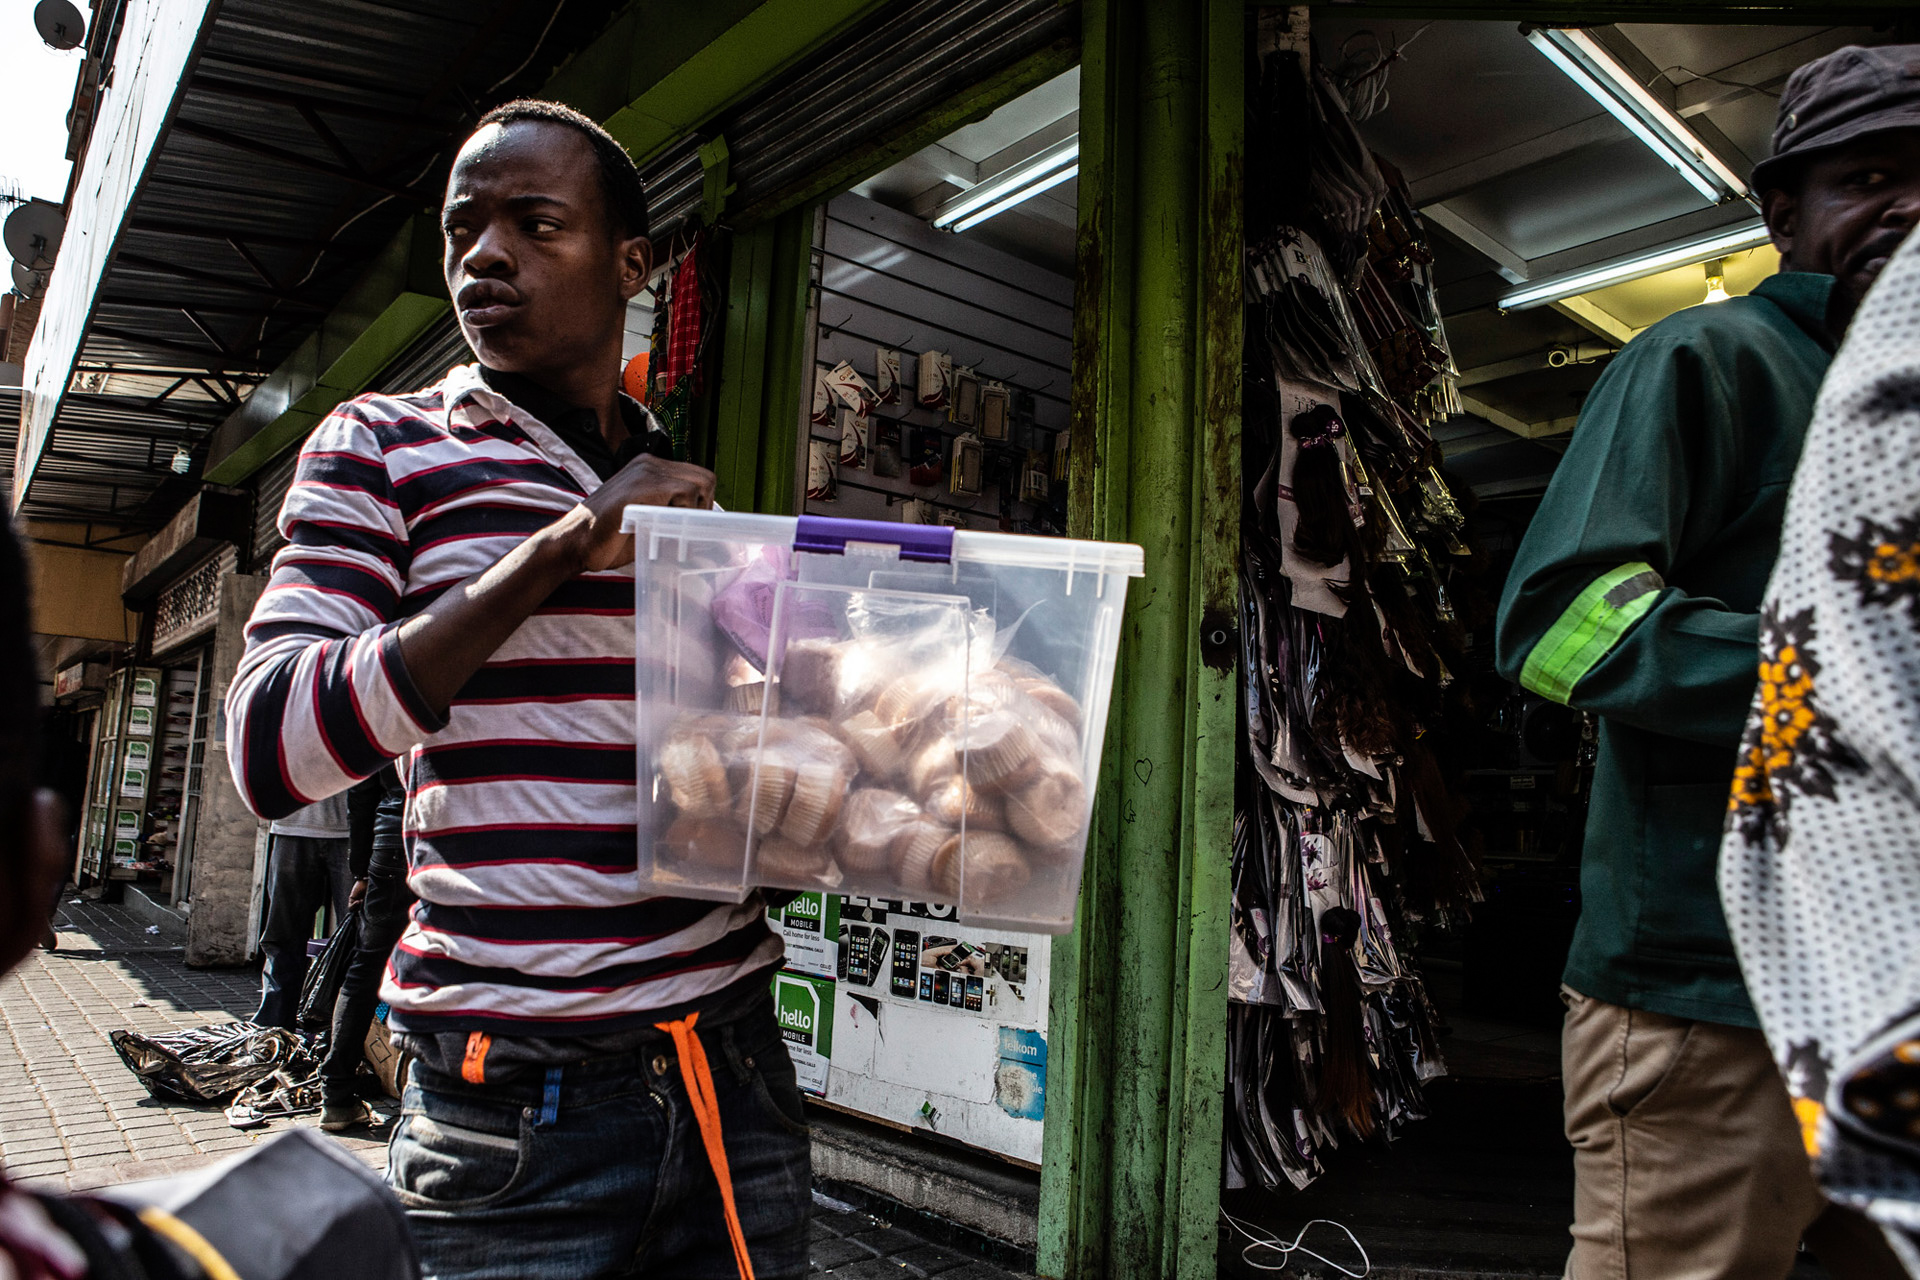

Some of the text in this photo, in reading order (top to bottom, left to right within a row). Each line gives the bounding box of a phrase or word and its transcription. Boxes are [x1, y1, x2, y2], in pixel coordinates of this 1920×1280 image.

[790, 918, 813, 930] MOBILE
[783, 929, 792, 937] Call
[792, 931, 804, 939] home
[811, 934, 820, 942] less
[780, 1004, 811, 1030] hello
[782, 1030, 806, 1043] MOBILE
[1003, 1038, 1037, 1056] Telkom
